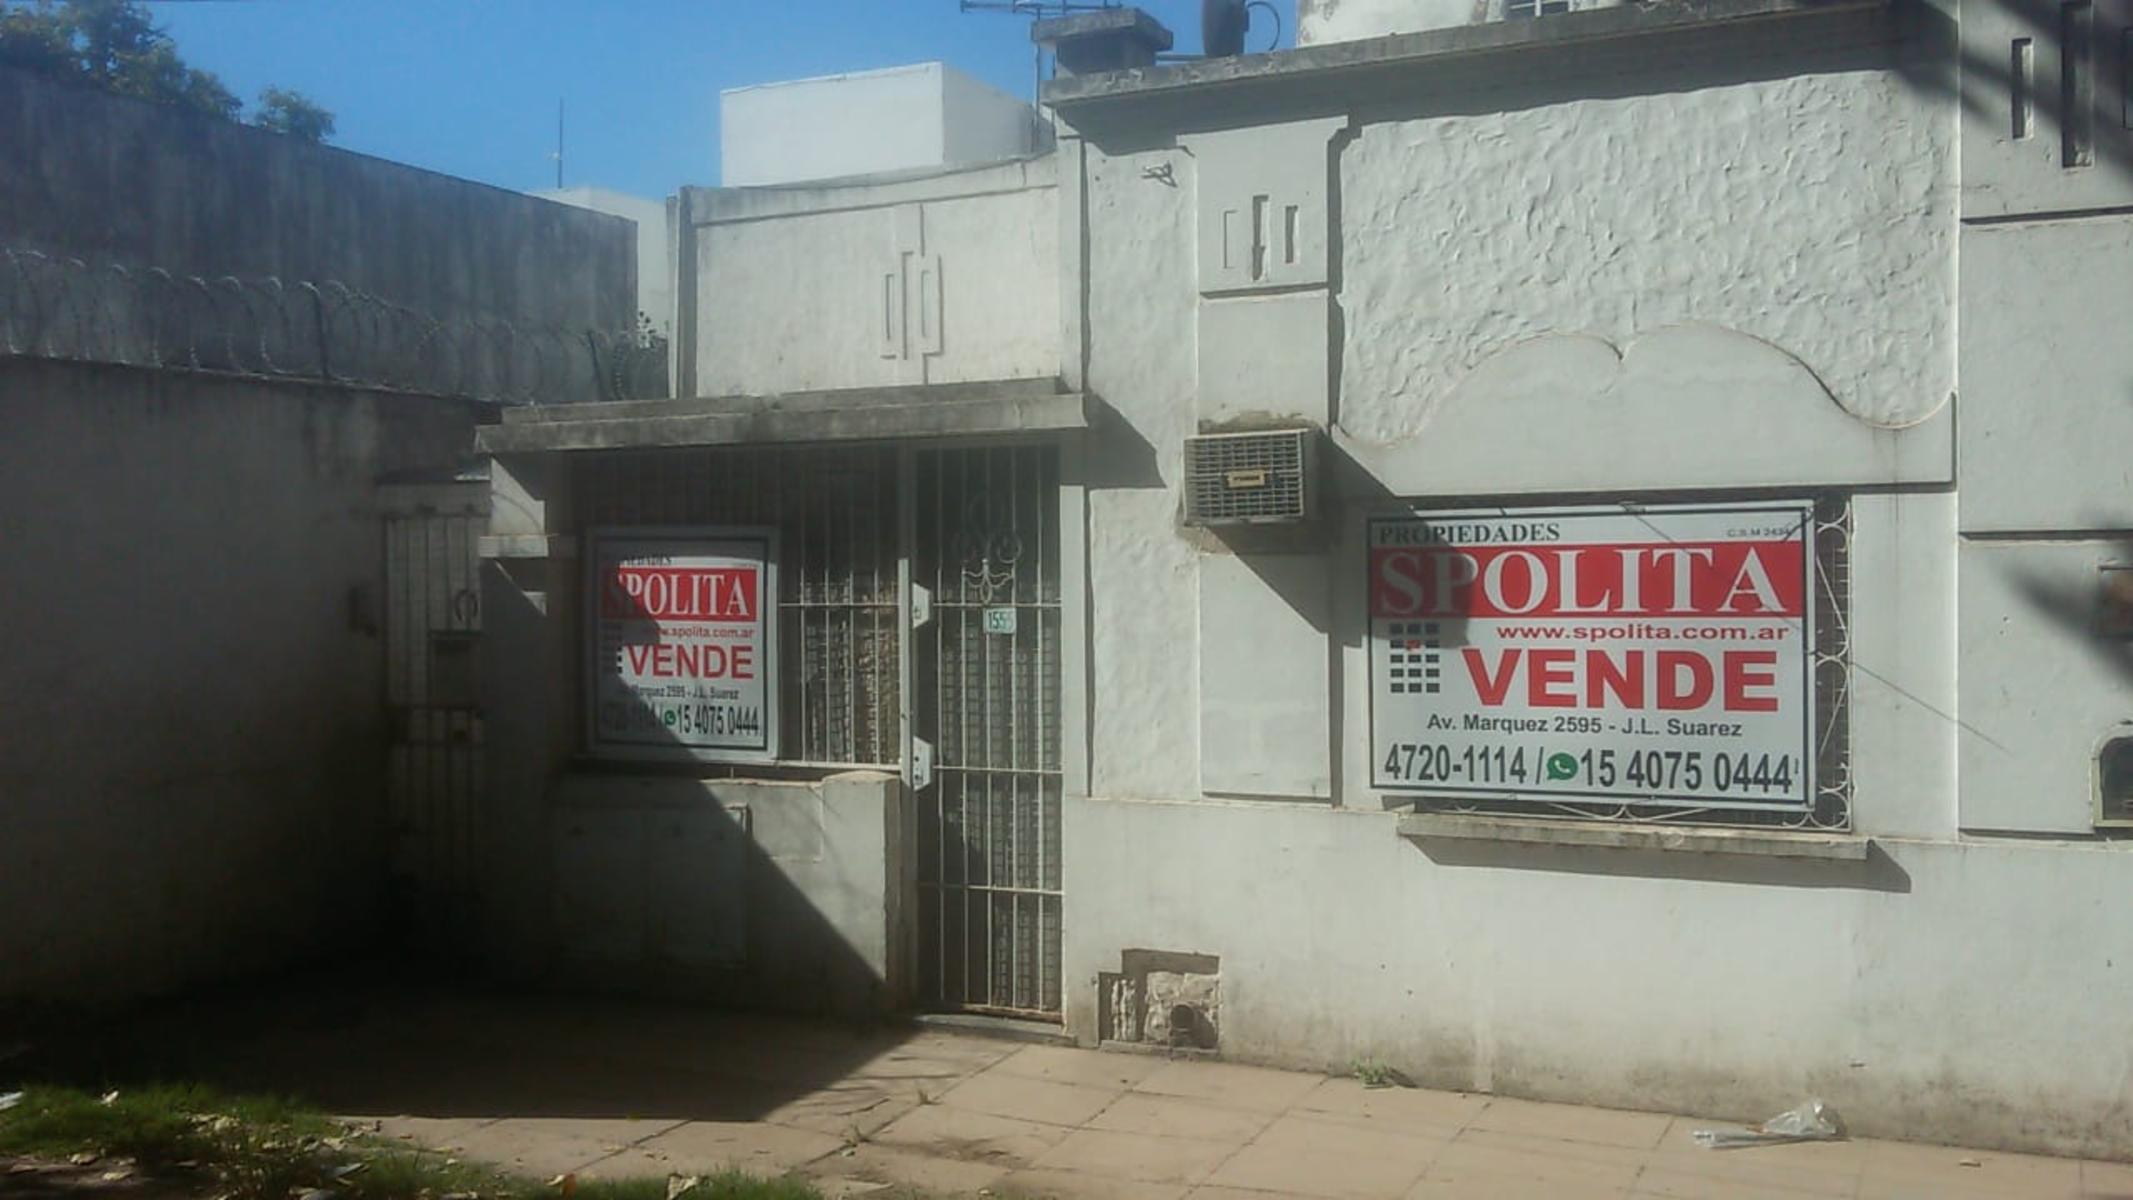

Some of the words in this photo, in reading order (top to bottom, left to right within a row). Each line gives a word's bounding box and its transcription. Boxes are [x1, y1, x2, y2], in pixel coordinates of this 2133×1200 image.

[1379, 523, 1561, 544] PROPIEDADES
[1380, 547, 1788, 614] SPOLITA
[1496, 623, 1789, 642] www.spolita.com.ar
[627, 644, 755, 680] VENDE
[1462, 647, 1779, 713] VENDE
[695, 705, 724, 734] 4075
[1427, 714, 1457, 730] Av.
[1463, 714, 1549, 733] Marquez
[1554, 716, 1602, 733] 2595
[1621, 718, 1660, 735] J.L.
[1667, 718, 1743, 737] Suarez
[1384, 743, 1527, 784] 4720-1114
[1580, 748, 1617, 788] 15
[1626, 749, 1703, 791] 4075
[1714, 752, 1793, 794] 0444
